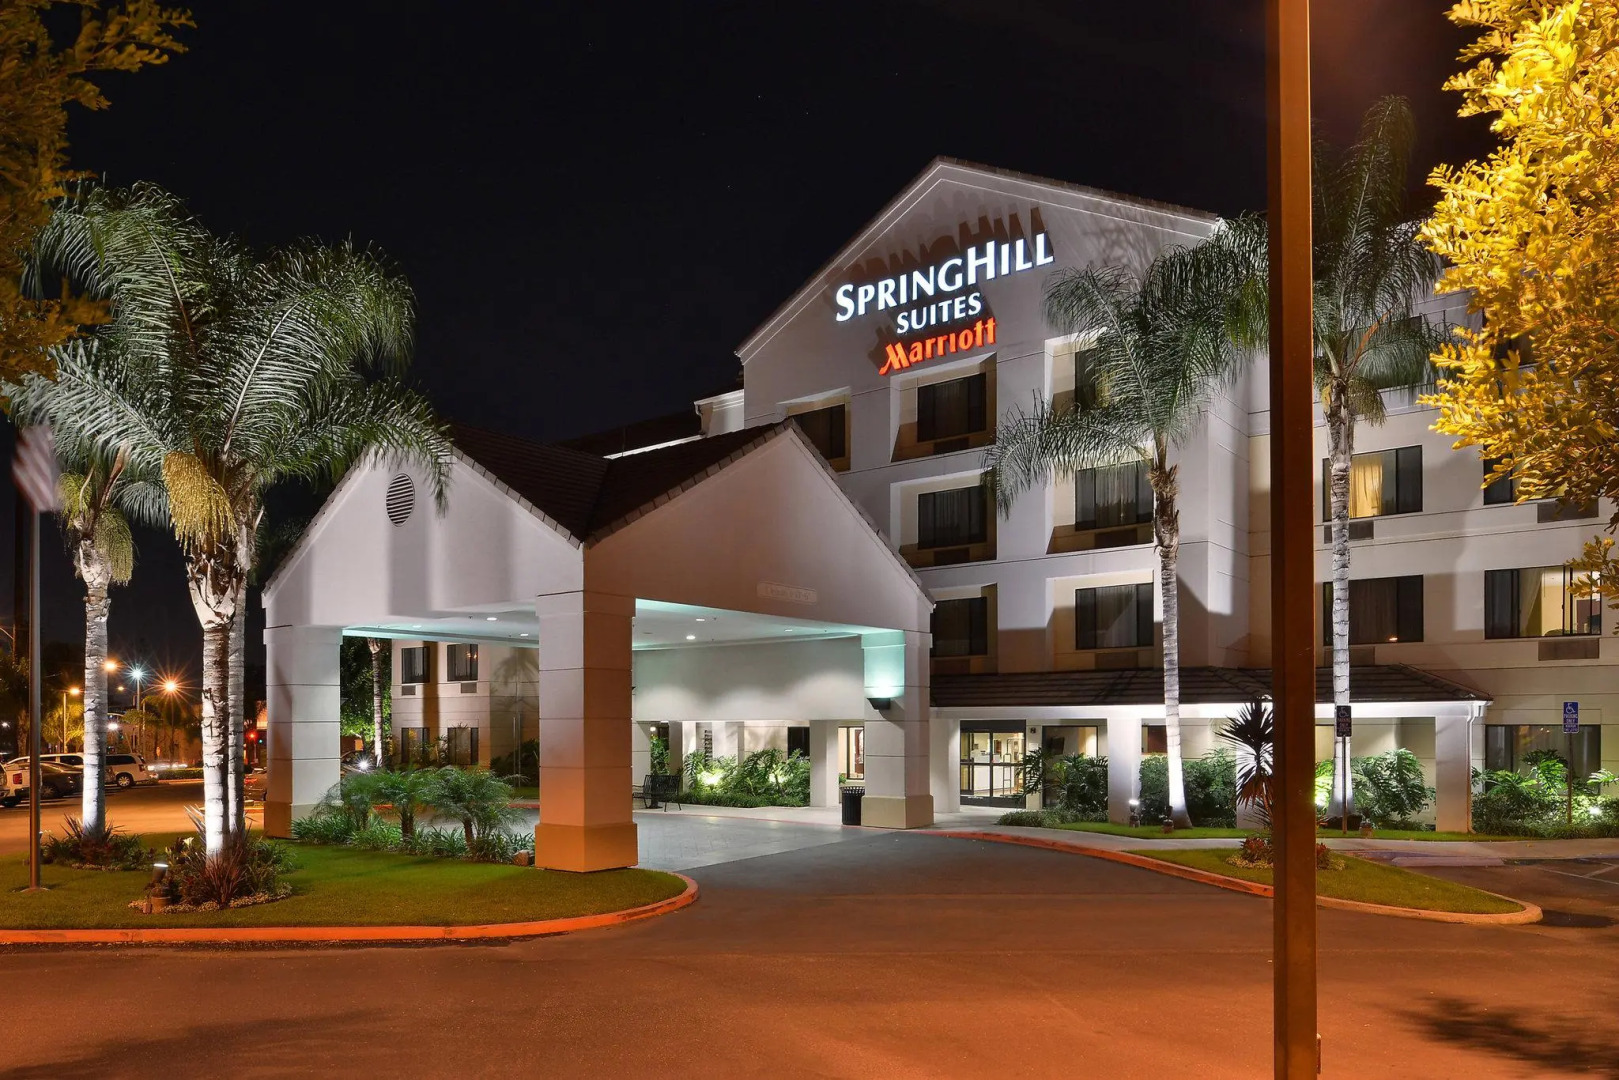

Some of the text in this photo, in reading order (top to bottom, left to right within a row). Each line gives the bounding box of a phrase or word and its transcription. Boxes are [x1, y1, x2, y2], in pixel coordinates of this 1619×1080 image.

[835, 232, 1054, 322] SPRINGHILL
[896, 291, 982, 334] SUITES
[878, 316, 997, 376] Marriott
